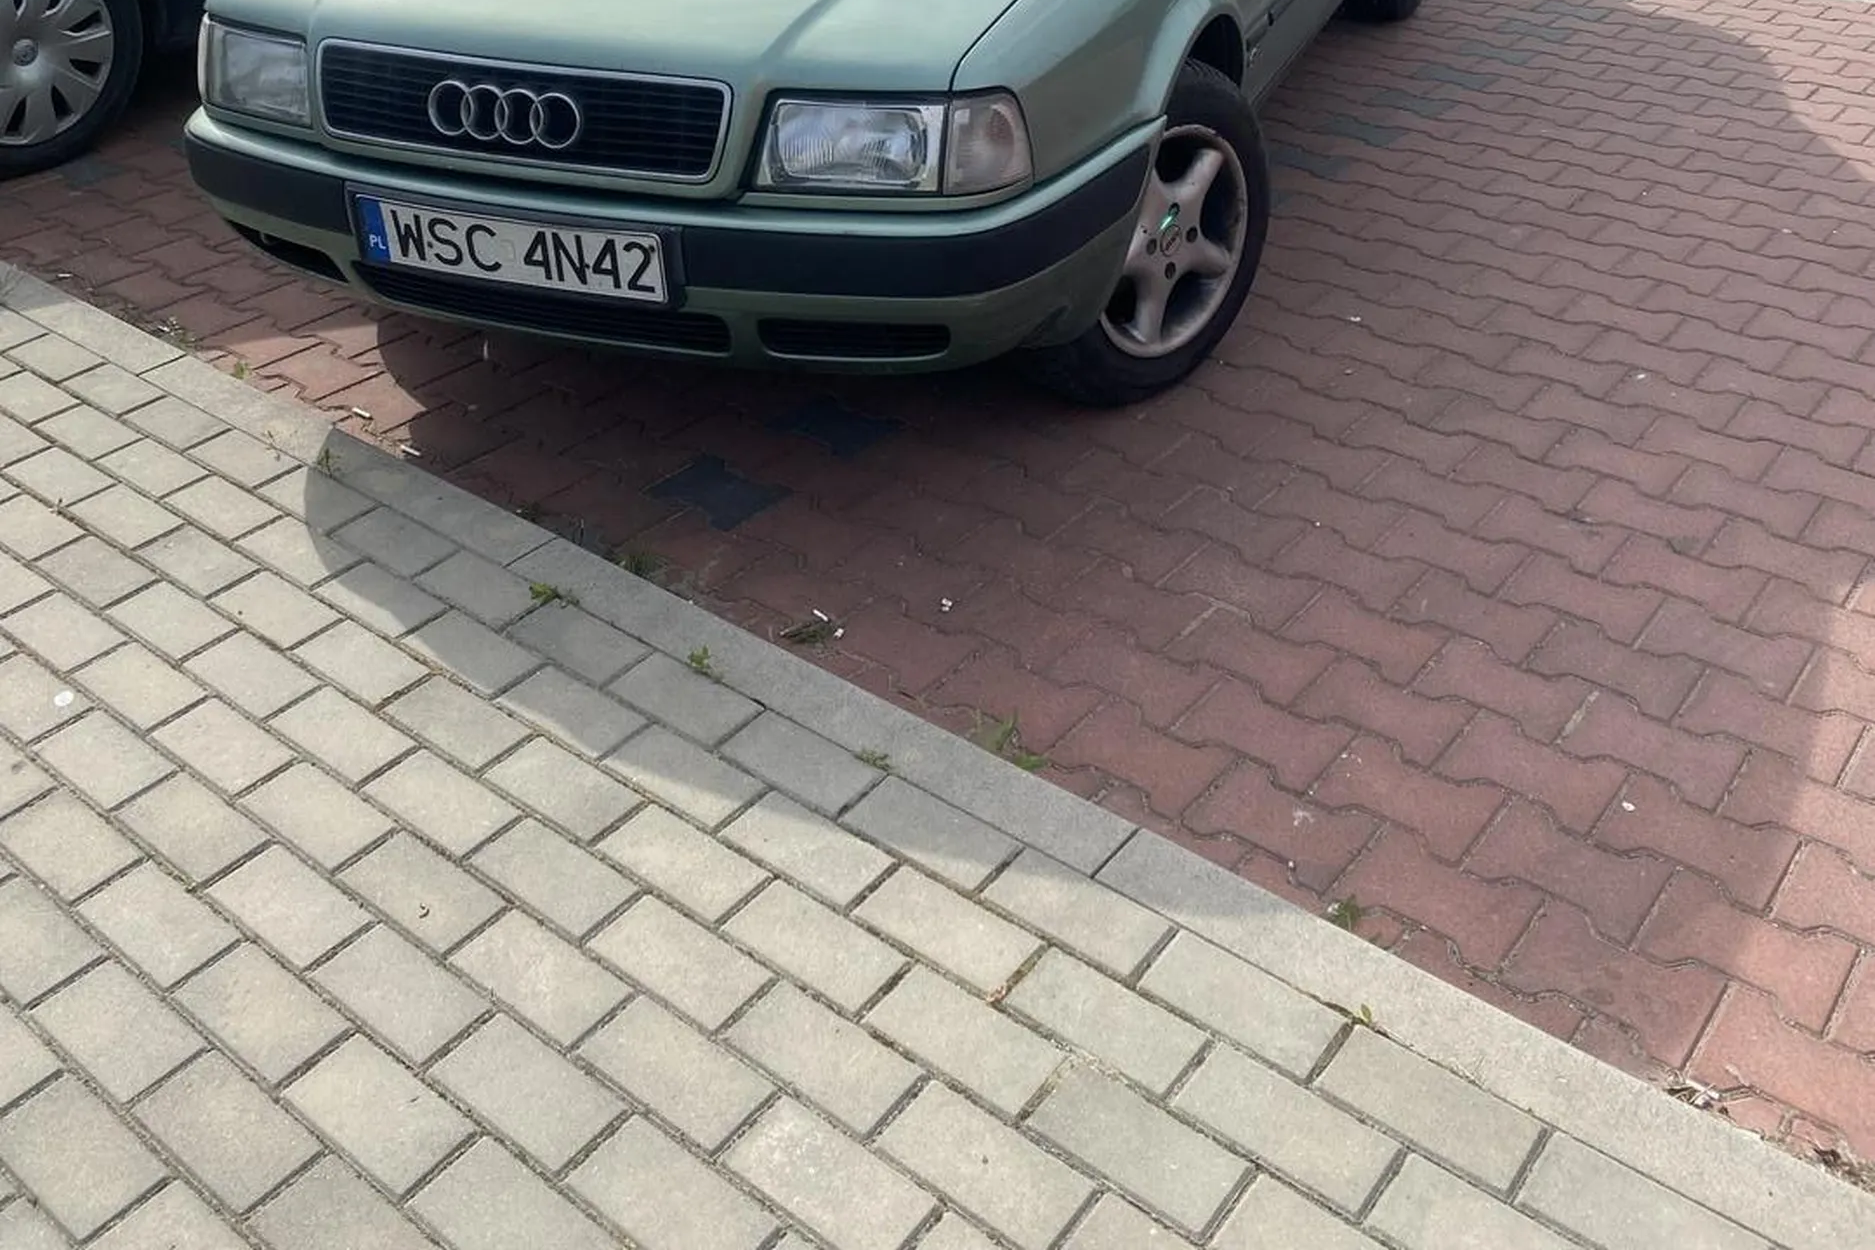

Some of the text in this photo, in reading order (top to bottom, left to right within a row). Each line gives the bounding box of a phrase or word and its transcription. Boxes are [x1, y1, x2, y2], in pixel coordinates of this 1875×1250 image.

[369, 234, 386, 250] PL
[391, 210, 656, 293] WSC 4N42
